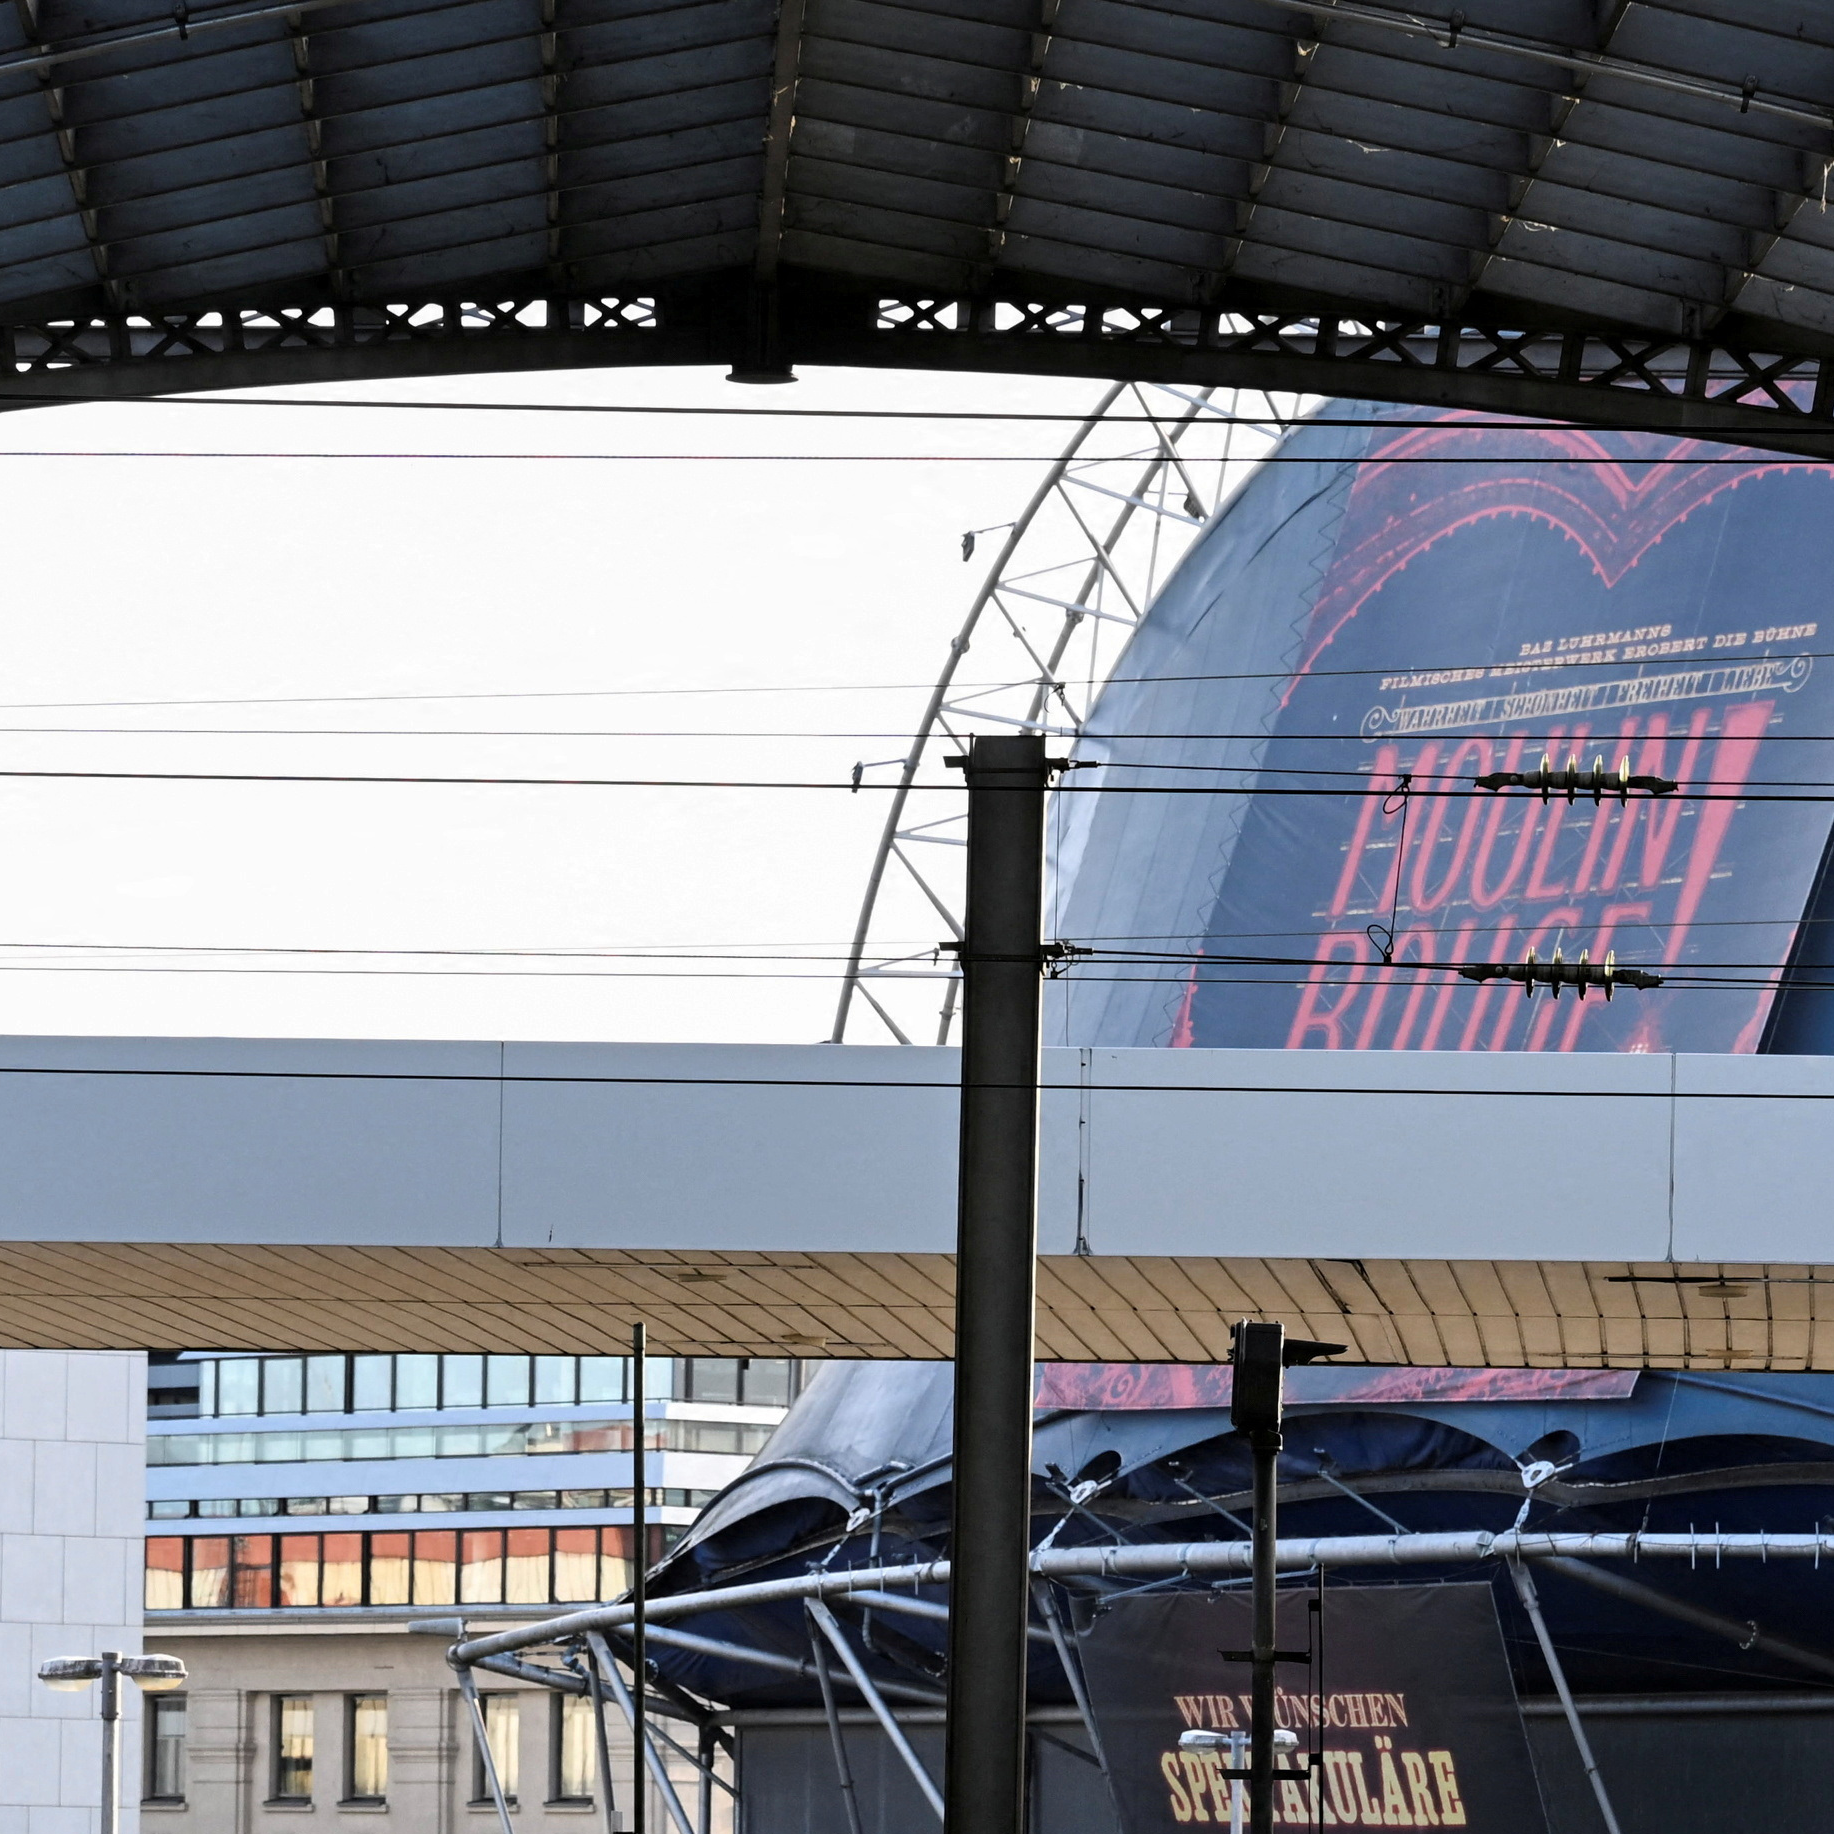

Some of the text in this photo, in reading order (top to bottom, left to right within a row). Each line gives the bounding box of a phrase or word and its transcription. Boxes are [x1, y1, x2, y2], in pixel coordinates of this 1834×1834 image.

[1379, 667, 1486, 691] FILMISCHES
[1622, 635, 1708, 661] EROBERT
[1712, 631, 1747, 649] DIE
[1751, 622, 1818, 644] BÜHNE
[1519, 622, 1673, 657] BAZ LUHRMANNS
[1396, 700, 1487, 731] WAHRHEIT
[1615, 672, 1704, 703] FREIHEIT
[1324, 706, 1713, 922] MOULIN
[1173, 1695, 1239, 1729] WIR
[1161, 1734, 1467, 1826] SPEAKULÄRE
